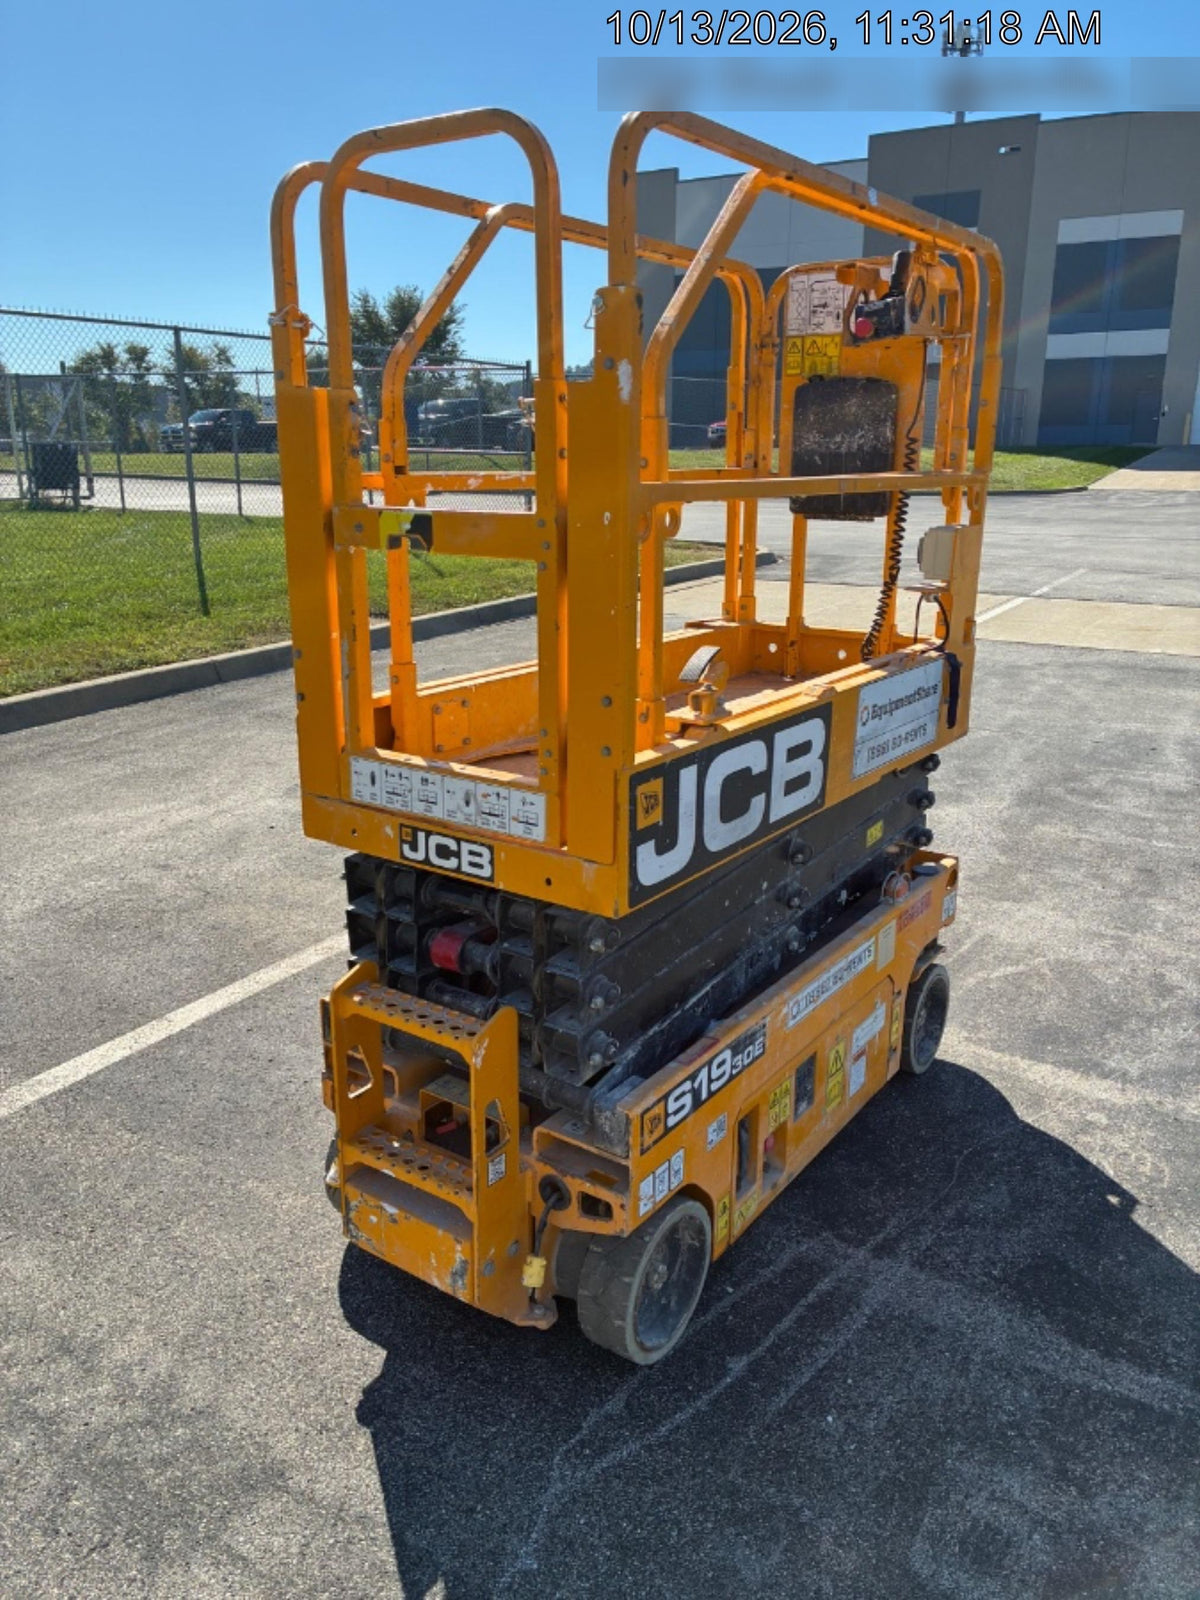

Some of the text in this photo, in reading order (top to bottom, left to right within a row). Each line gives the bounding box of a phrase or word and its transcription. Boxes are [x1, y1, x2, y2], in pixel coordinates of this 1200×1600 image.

[871, 683, 939, 720] EquipmentShare
[636, 718, 827, 887] JCB
[402, 831, 492, 878] JCB
